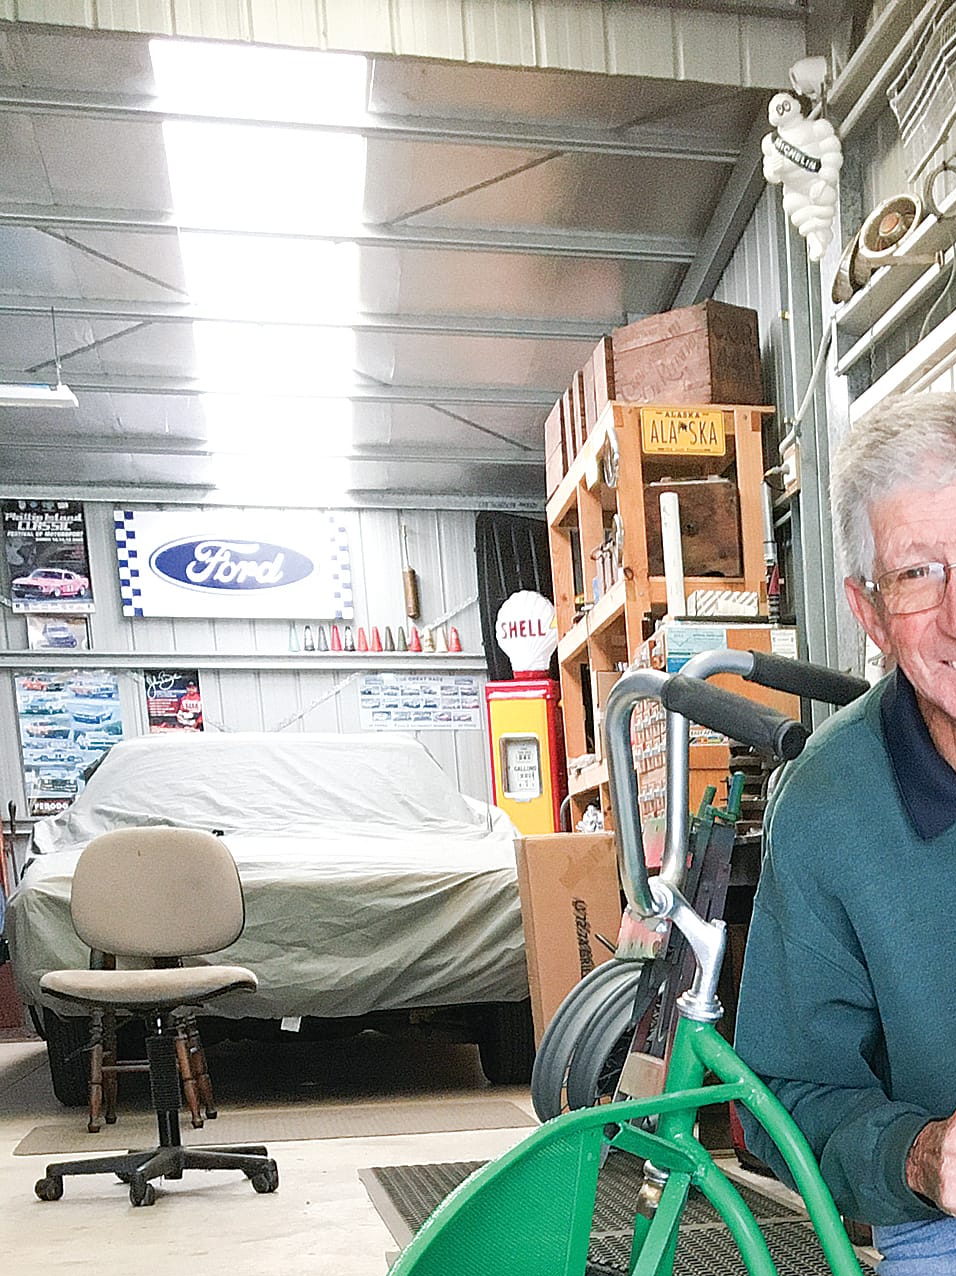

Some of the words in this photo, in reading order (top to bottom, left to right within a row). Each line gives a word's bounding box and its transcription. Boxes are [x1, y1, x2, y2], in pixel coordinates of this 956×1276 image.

[775, 138, 817, 170] MICHELIN
[17, 521, 74, 531] CLASSIC
[185, 541, 285, 584] Ford
[501, 618, 547, 640] SHELL
[34, 802, 69, 811] FERODO
